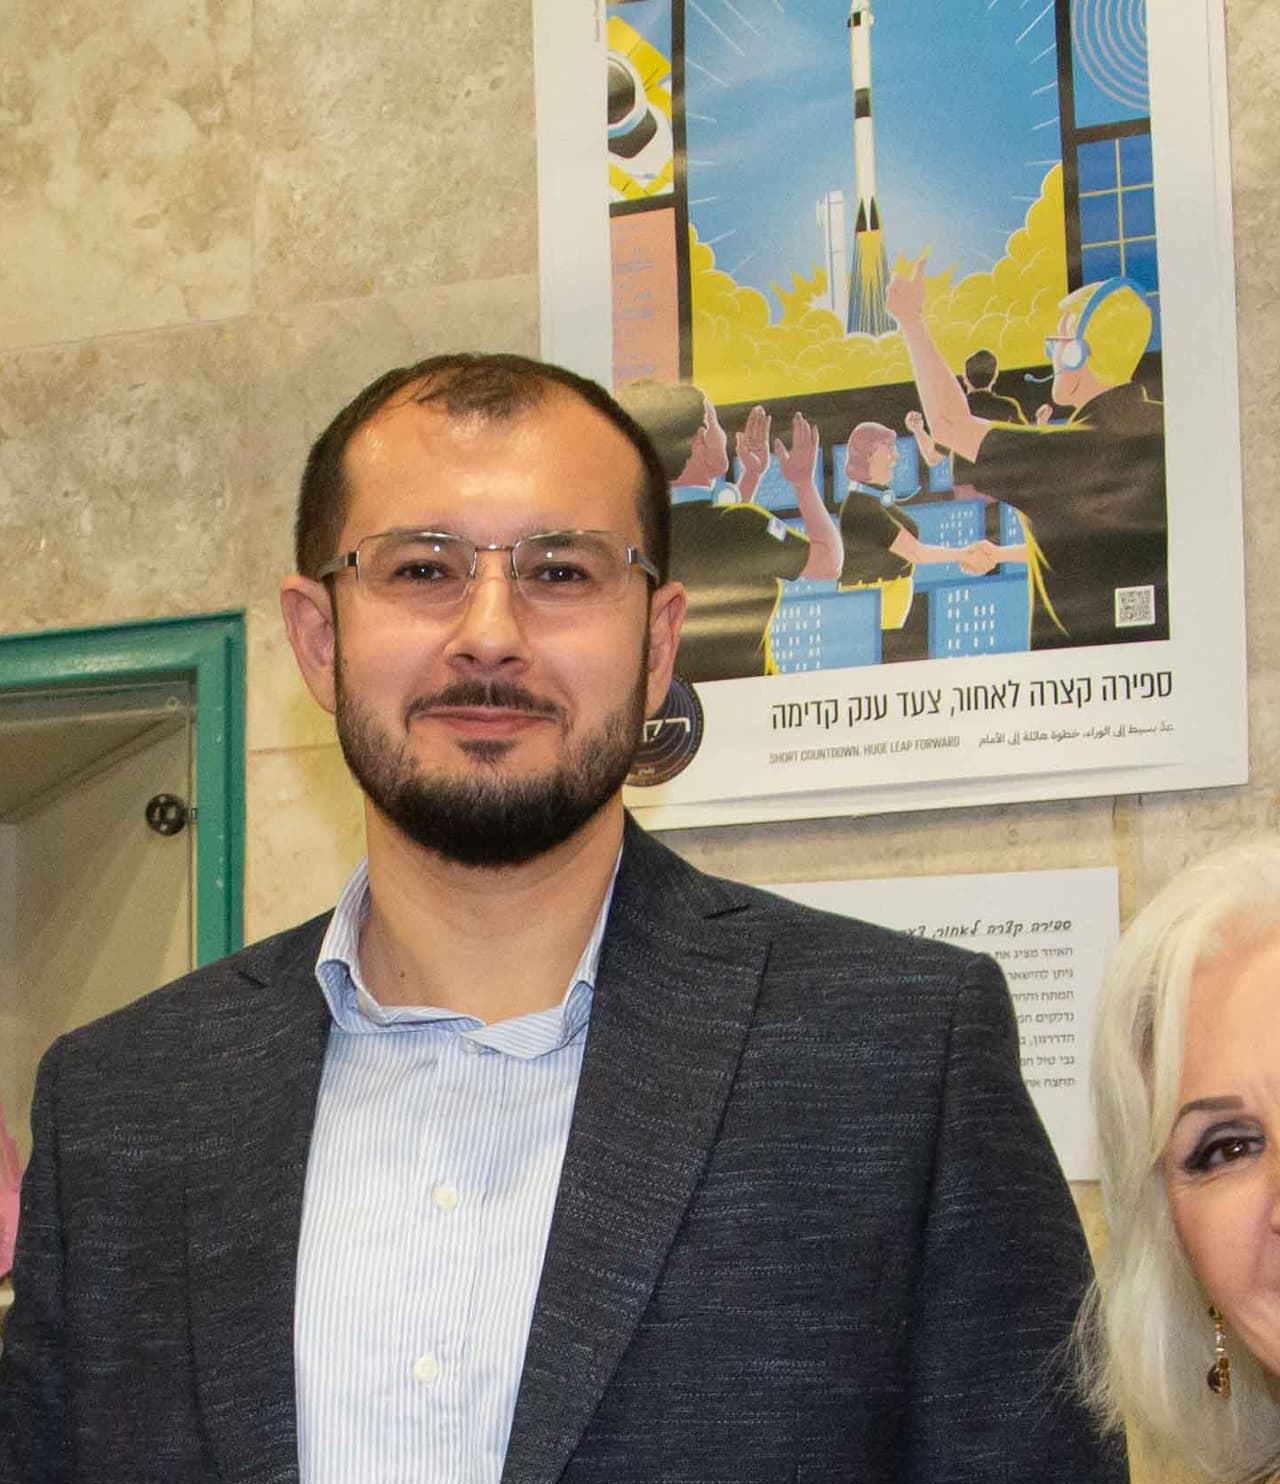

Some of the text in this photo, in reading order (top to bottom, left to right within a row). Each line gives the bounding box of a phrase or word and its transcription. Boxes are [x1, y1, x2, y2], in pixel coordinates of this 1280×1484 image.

[772, 671, 1172, 729] ספירה קצרה לאחור, צעד ענק קדימה
[769, 751, 799, 764] SHORT
[864, 742, 889, 757] HUGE
[890, 739, 913, 753] LEAP
[915, 735, 960, 751] FORWARD
[904, 924, 927, 939] צע
[987, 920, 1024, 937] קצרה
[1031, 920, 1072, 933] ספירה
